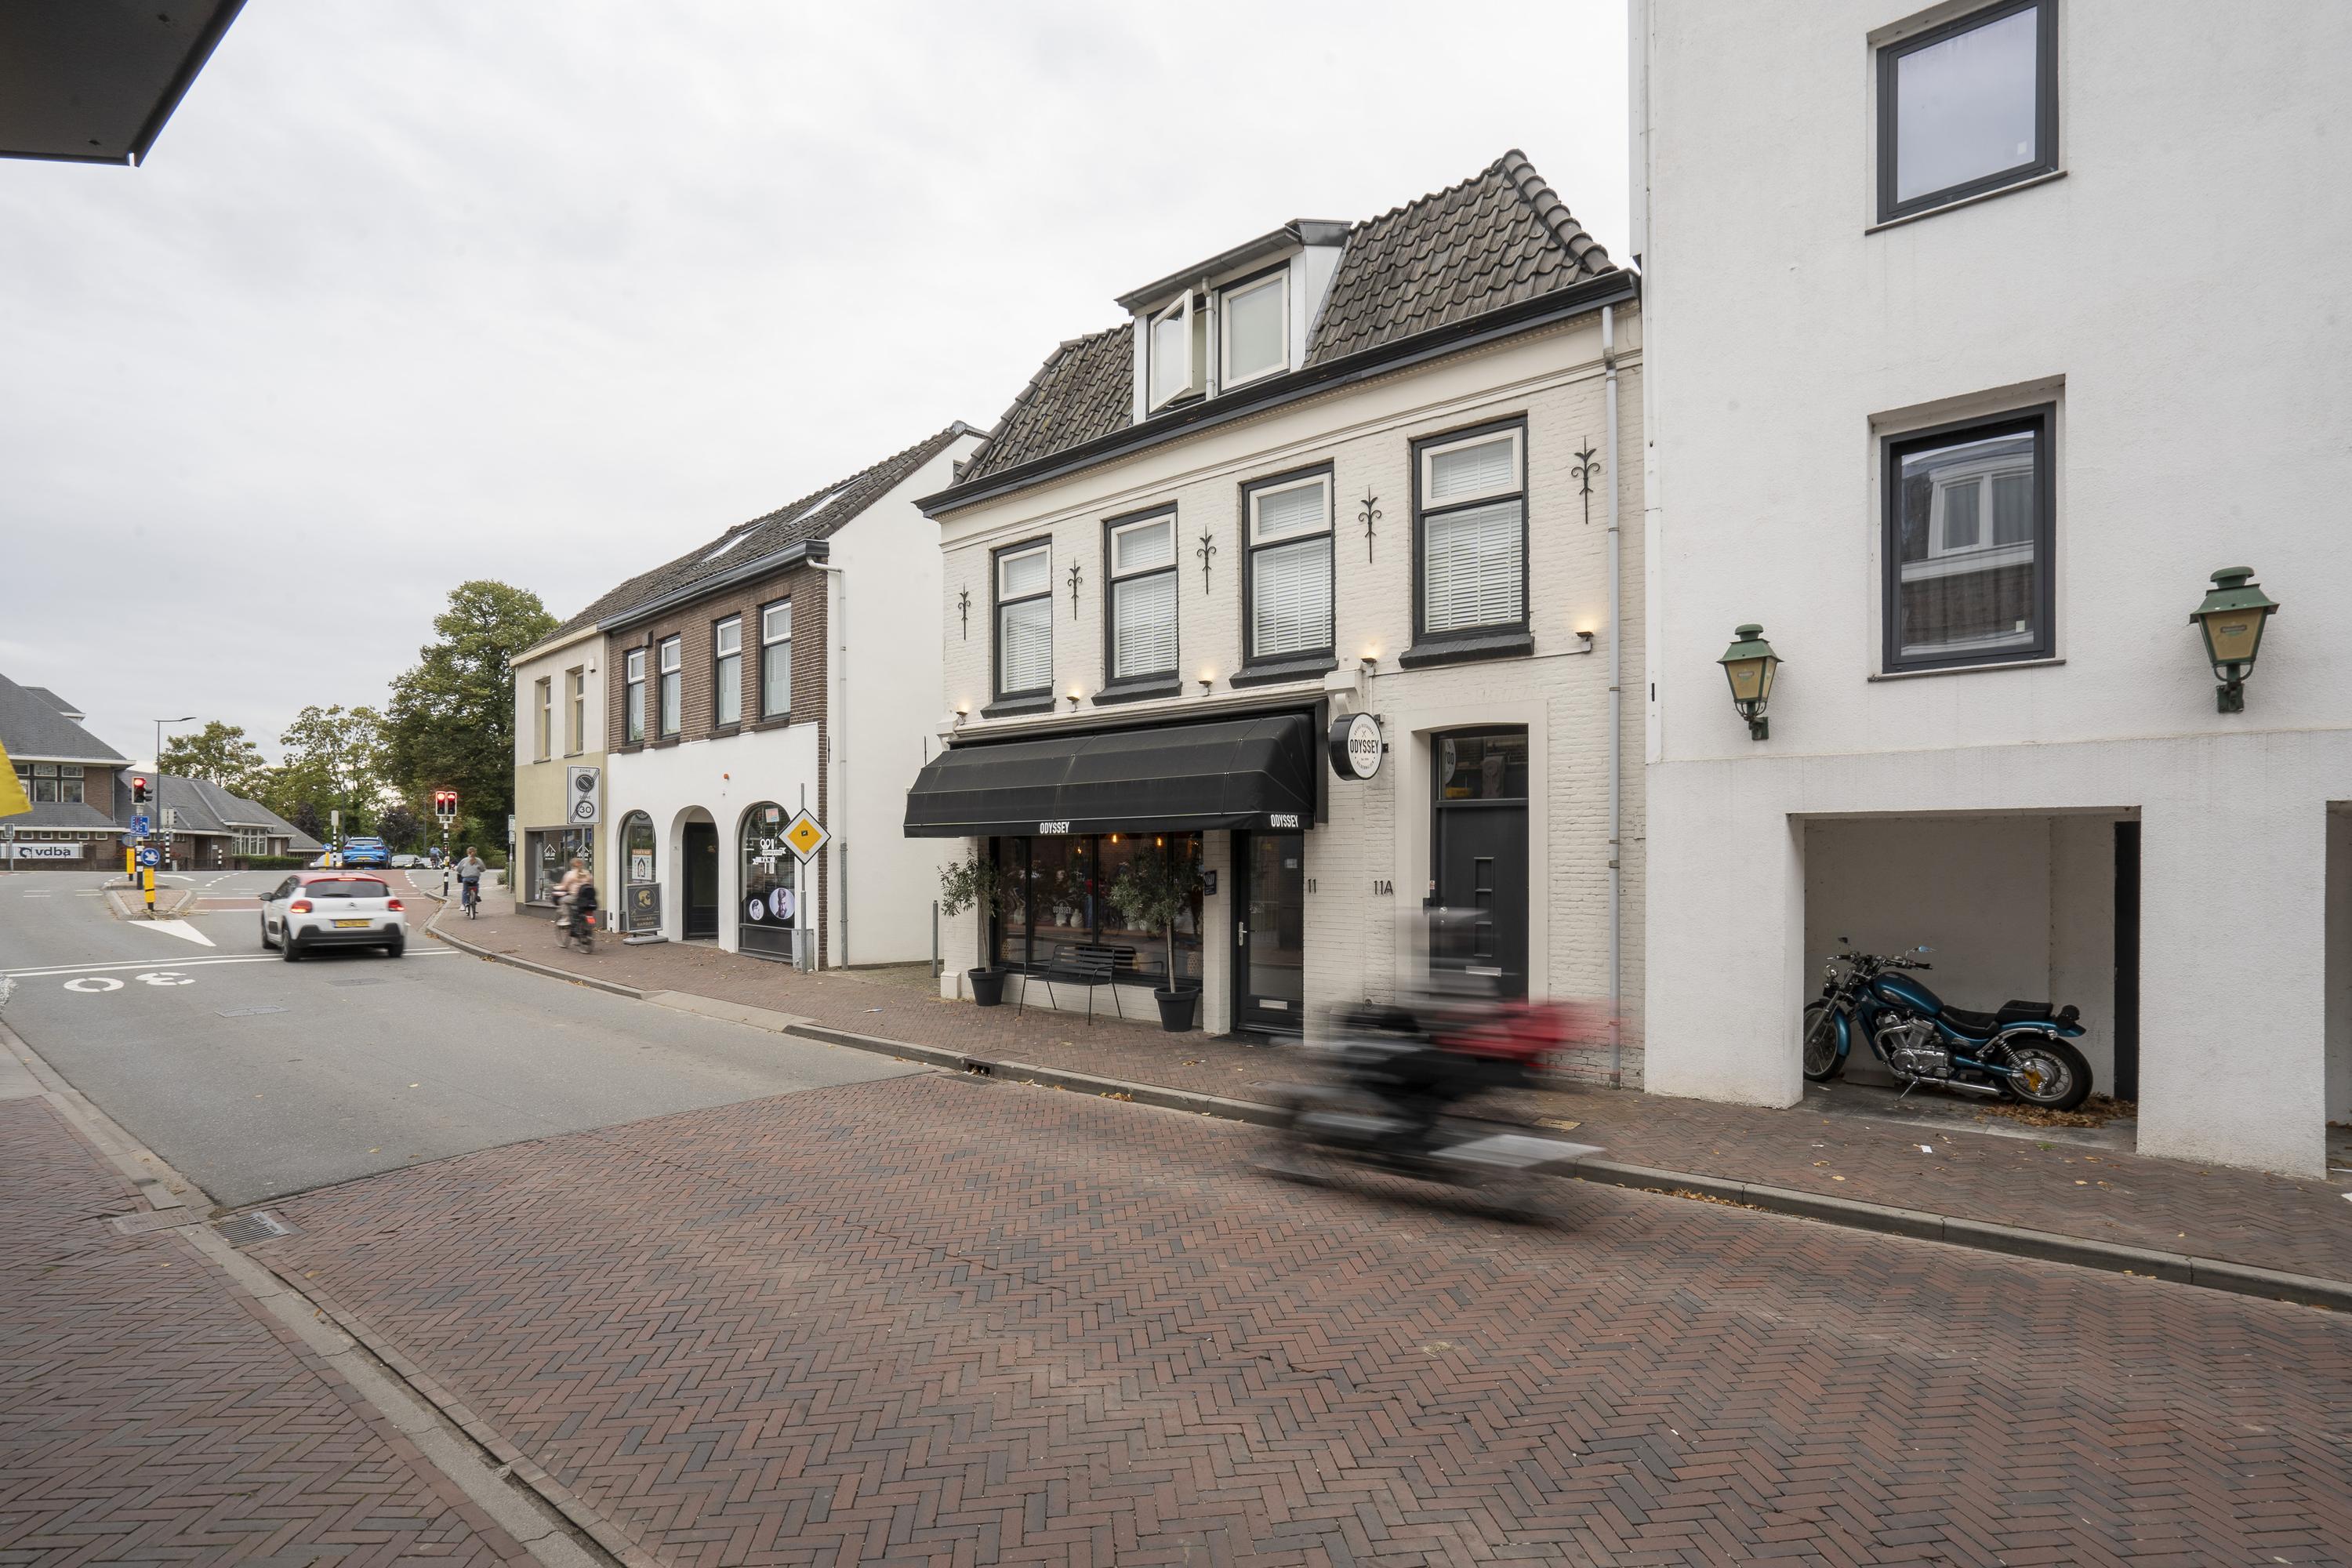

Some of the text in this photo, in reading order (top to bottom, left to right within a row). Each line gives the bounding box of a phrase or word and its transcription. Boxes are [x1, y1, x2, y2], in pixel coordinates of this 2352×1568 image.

[1349, 739, 1379, 753] ODYSSEY
[1040, 821, 1069, 834] ODYSSEY
[1271, 815, 1299, 828] ODYSSEY
[35, 847, 71, 856] vdba
[1308, 879, 1316, 893] 11
[1374, 880, 1393, 895] 11A
[1053, 906, 1072, 914] ODYSSEY
